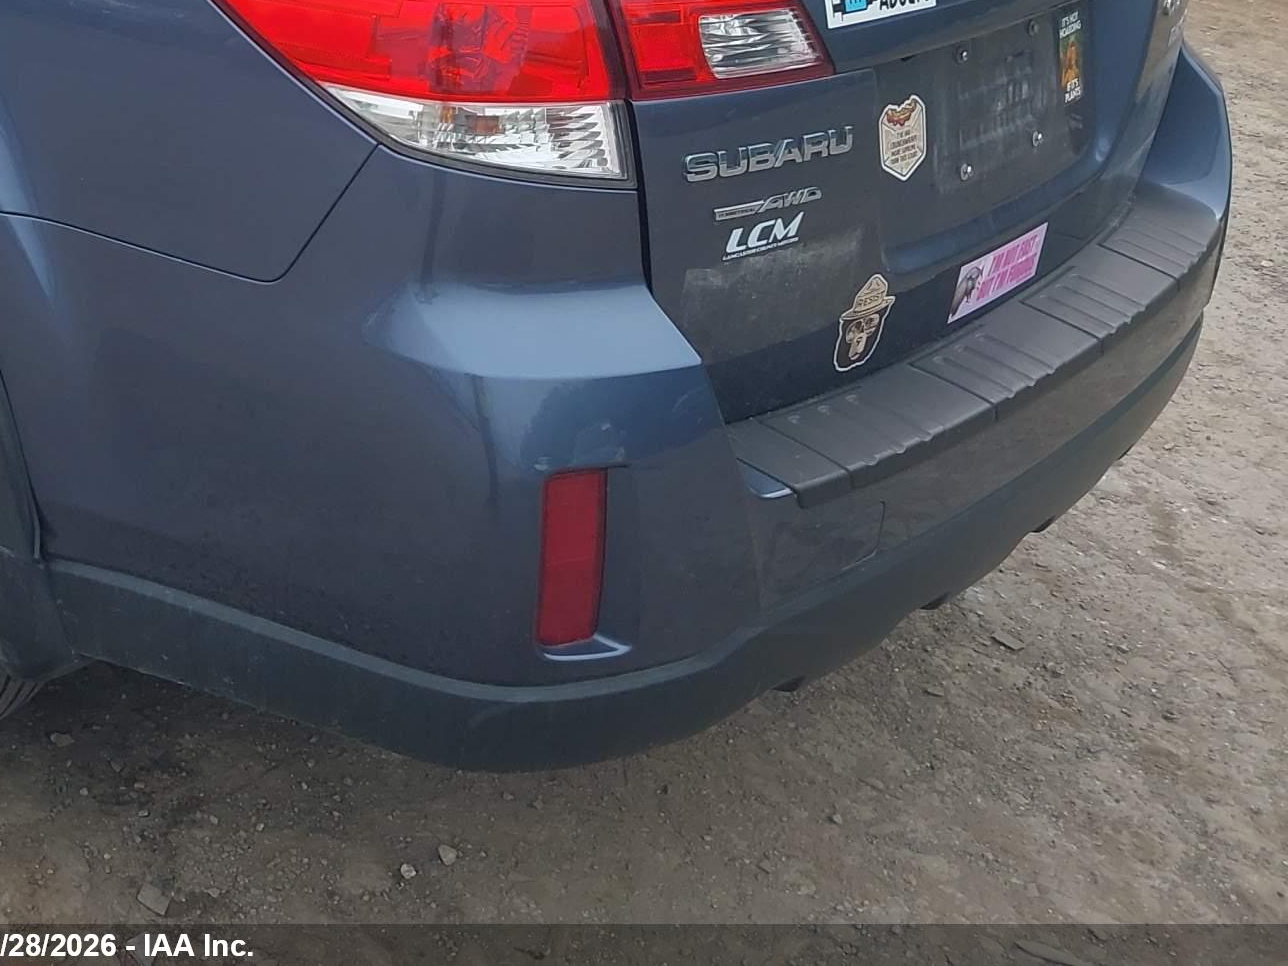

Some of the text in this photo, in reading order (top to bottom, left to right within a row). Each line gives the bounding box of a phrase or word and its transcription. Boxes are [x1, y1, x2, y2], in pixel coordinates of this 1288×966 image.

[684, 125, 854, 182] SUBARU
[757, 186, 822, 213] AWD
[725, 211, 805, 253] LCM
